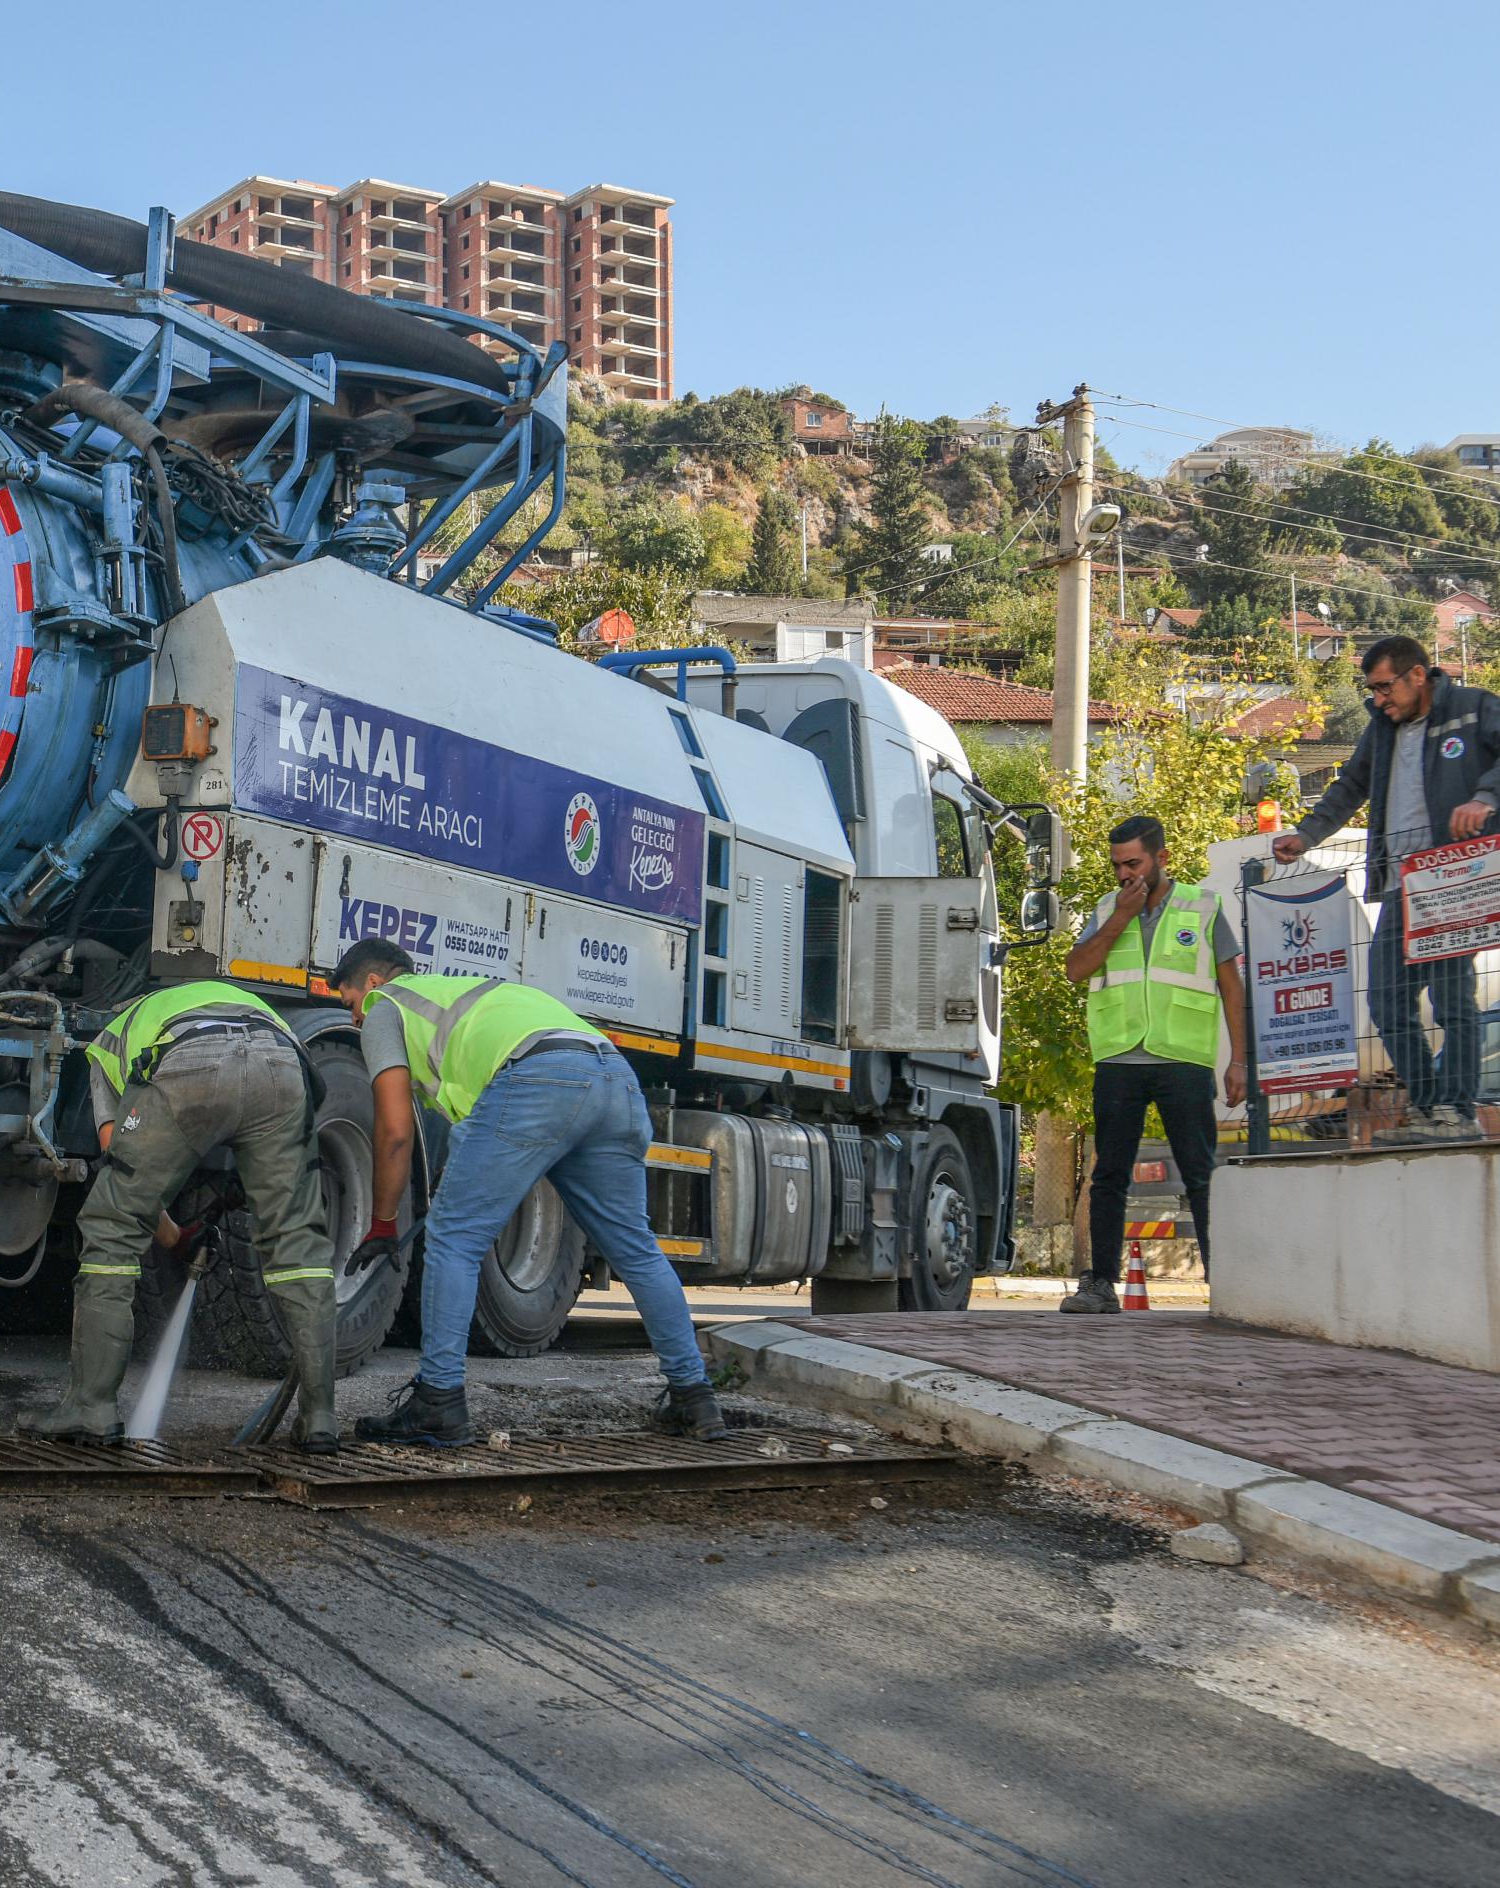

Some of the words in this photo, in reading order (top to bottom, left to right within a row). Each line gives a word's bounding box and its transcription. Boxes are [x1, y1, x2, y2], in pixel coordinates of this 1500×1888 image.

[278, 695, 426, 791] KANAL
[206, 780, 223, 790] 281
[278, 760, 412, 830] TEMİZLEME
[417, 802, 483, 849] ARACI
[631, 824, 676, 852] GELECEĞİ
[339, 895, 438, 956] KEPEZ
[447, 918, 489, 938] WHATSAPP
[489, 928, 510, 945] HATTI
[445, 935, 467, 953] 0555
[468, 940, 485, 956] 024
[486, 945, 497, 958] 07
[498, 948, 509, 961] 07
[577, 964, 628, 988] kepezbelediyesi
[1278, 994, 1286, 1012] 1
[1290, 988, 1330, 1010] GÜNDE
[1269, 1014, 1305, 1029] DOĞALGAZ
[1307, 1009, 1339, 1023] TESİSATI
